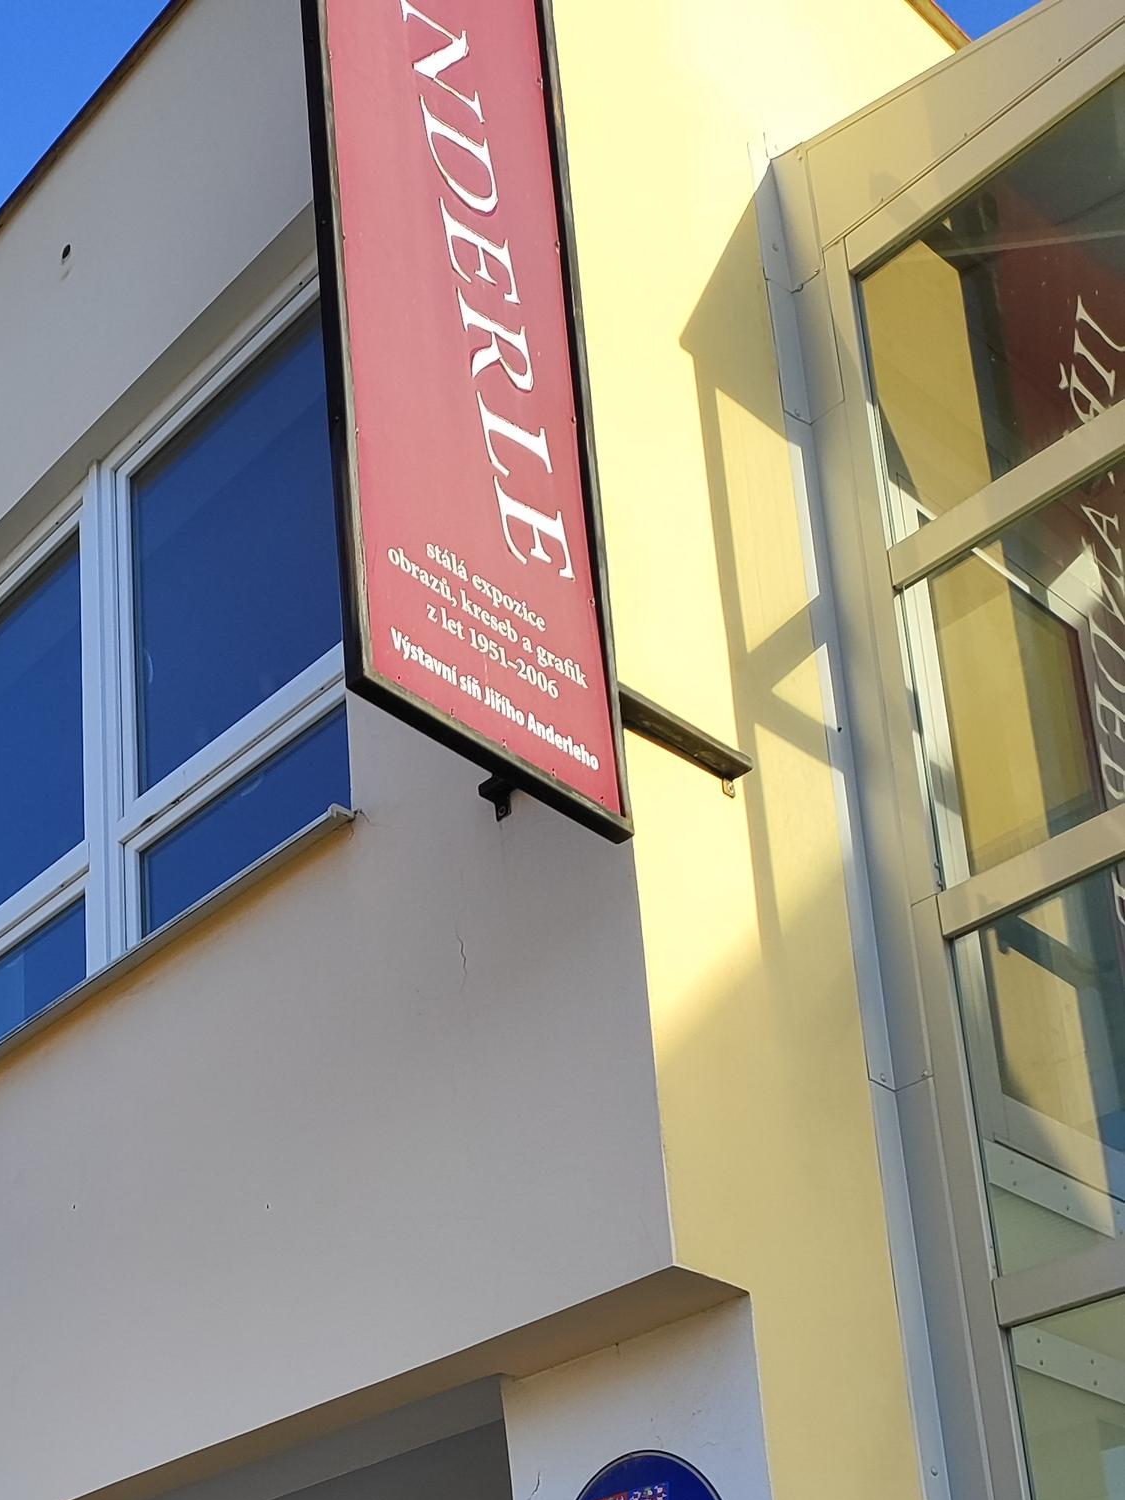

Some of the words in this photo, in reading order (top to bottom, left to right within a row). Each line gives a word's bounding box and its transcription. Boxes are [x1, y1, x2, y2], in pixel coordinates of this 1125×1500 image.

[387, 547, 458, 606] obrazů,
[461, 591, 519, 644] kreseb
[522, 636, 533, 655] a
[537, 644, 589, 690] grafik
[425, 542, 469, 582] stálá
[471, 573, 546, 632] expozice
[426, 603, 438, 624] z
[440, 606, 466, 642] let
[390, 627, 457, 685] Výstavní
[460, 672, 483, 702] síň
[484, 685, 525, 727] Jiřího
[527, 714, 599, 771] Anderleho
